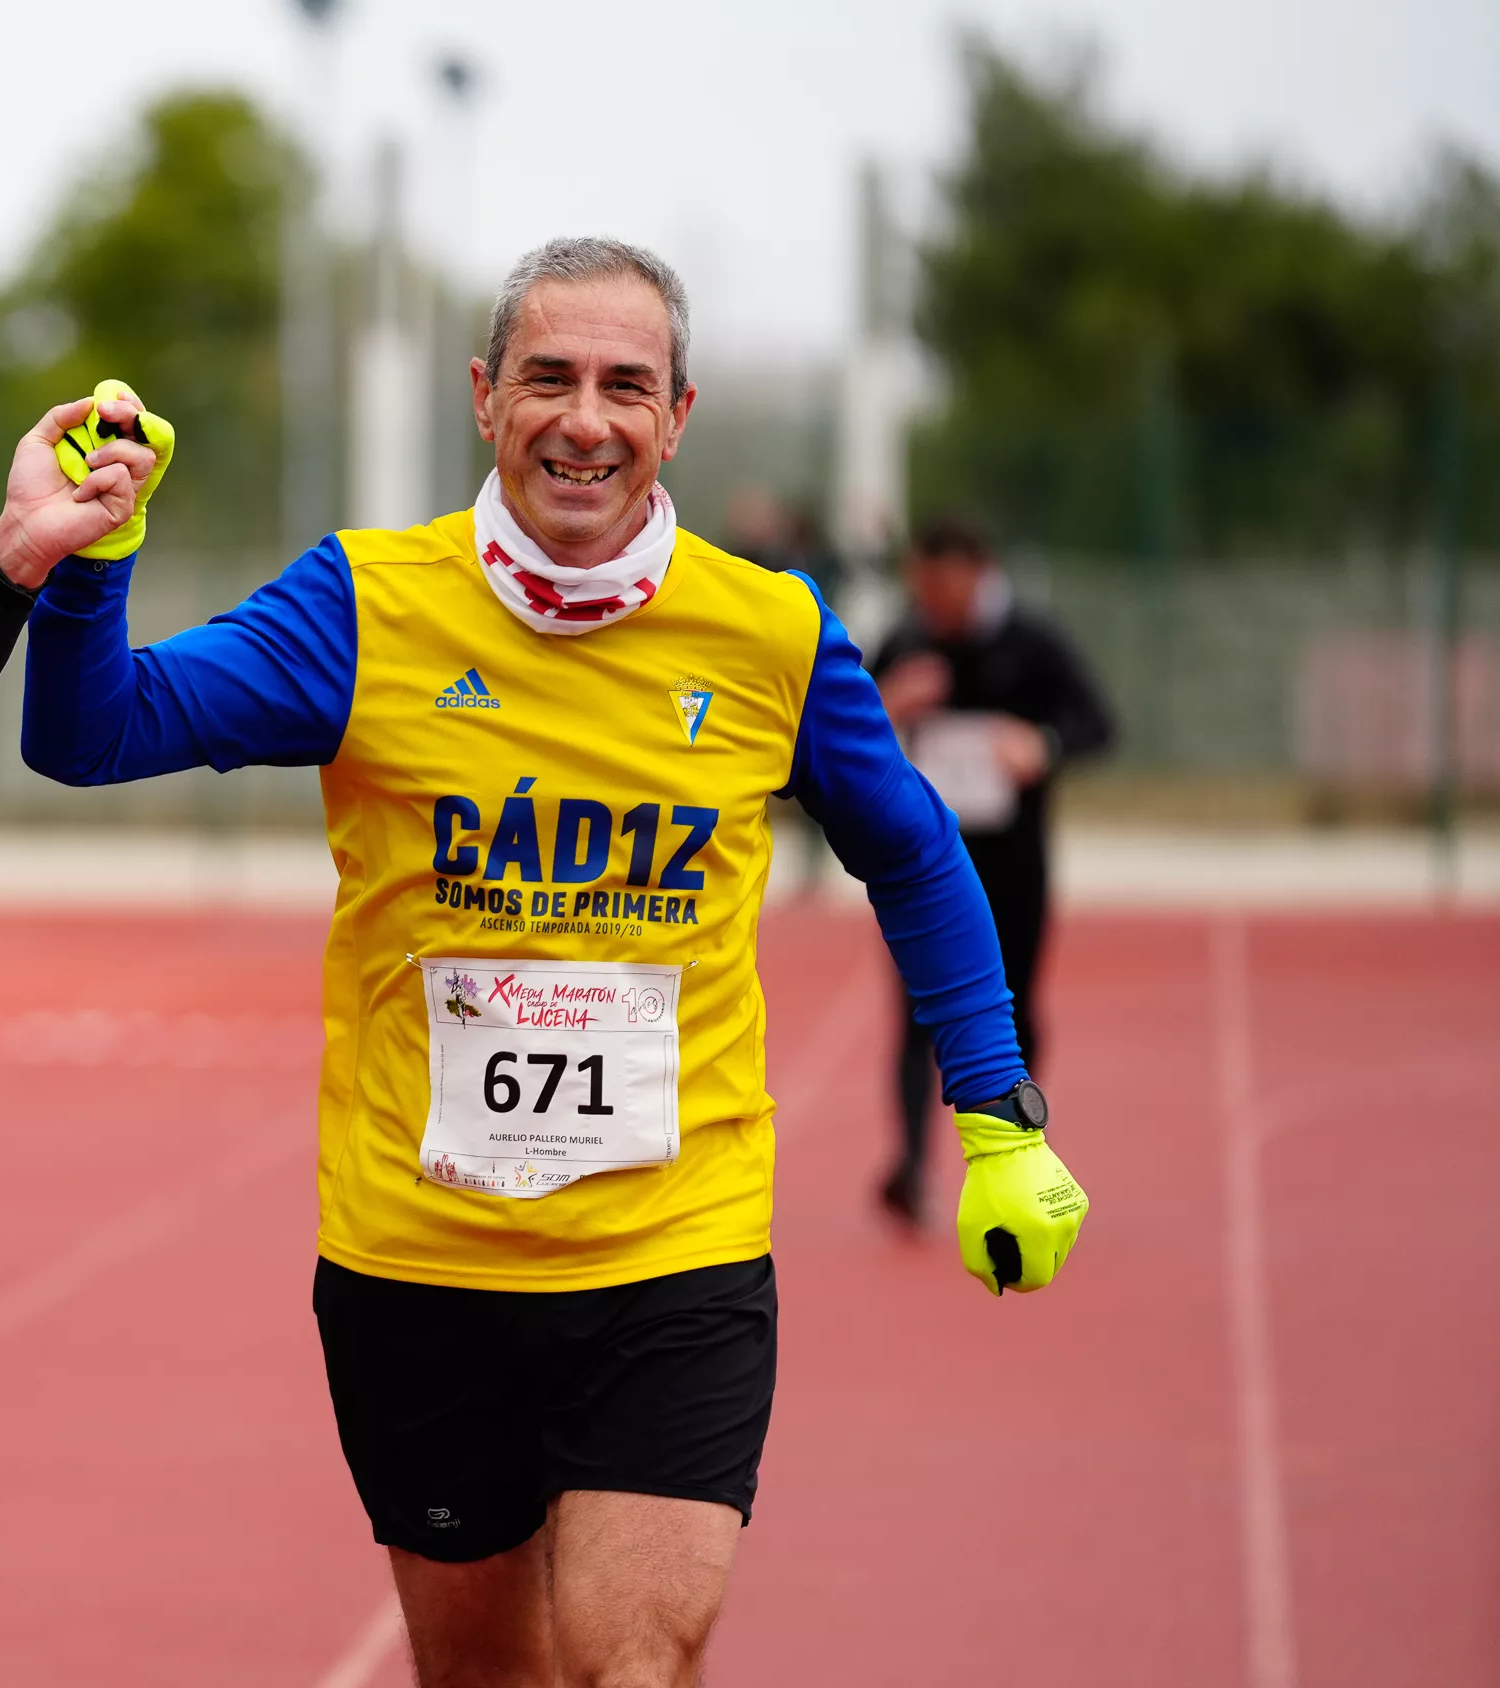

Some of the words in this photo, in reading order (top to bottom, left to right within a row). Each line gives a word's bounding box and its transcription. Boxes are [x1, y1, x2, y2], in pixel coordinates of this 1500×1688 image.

[435, 693, 501, 709] adidas
[433, 776, 720, 890] CÁD1Z
[435, 878, 523, 916] SOMOS
[531, 891, 567, 917] DE
[573, 891, 699, 925] PRIMERA
[480, 917, 525, 932] ASCENSO
[530, 921, 591, 934] TEMPORADA
[596, 922, 642, 938] 2019/20
[517, 1002, 600, 1030] LUCENA
[483, 1050, 614, 1115] 671
[489, 1133, 527, 1143] AURELIO
[529, 1134, 567, 1144] PALLERO
[569, 1135, 603, 1145] MURIEL
[525, 1147, 567, 1157] L-Hombre
